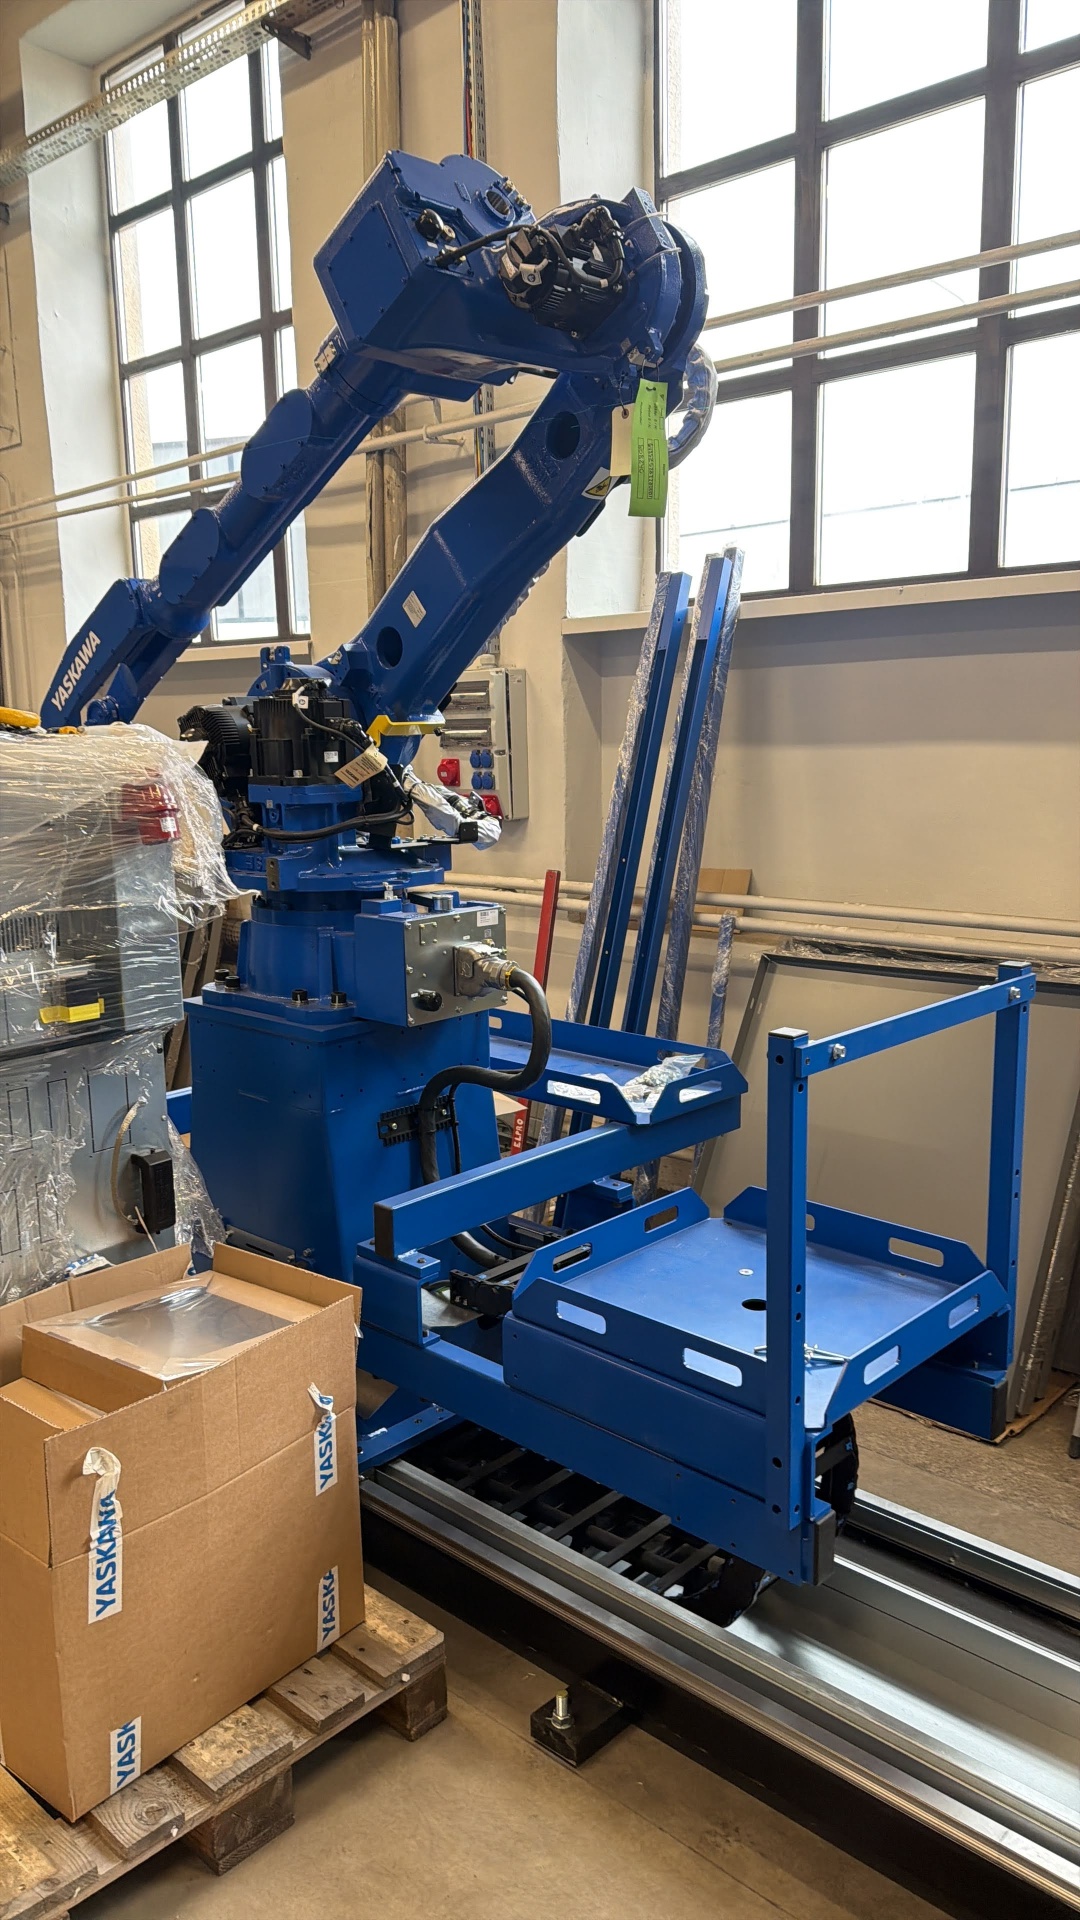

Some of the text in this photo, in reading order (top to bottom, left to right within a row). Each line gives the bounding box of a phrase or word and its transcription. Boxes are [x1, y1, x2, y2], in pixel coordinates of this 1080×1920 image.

[51, 630, 101, 711] YASKAWA
[513, 1118, 524, 1148] ELPRO
[318, 1394, 334, 1490] YASK
